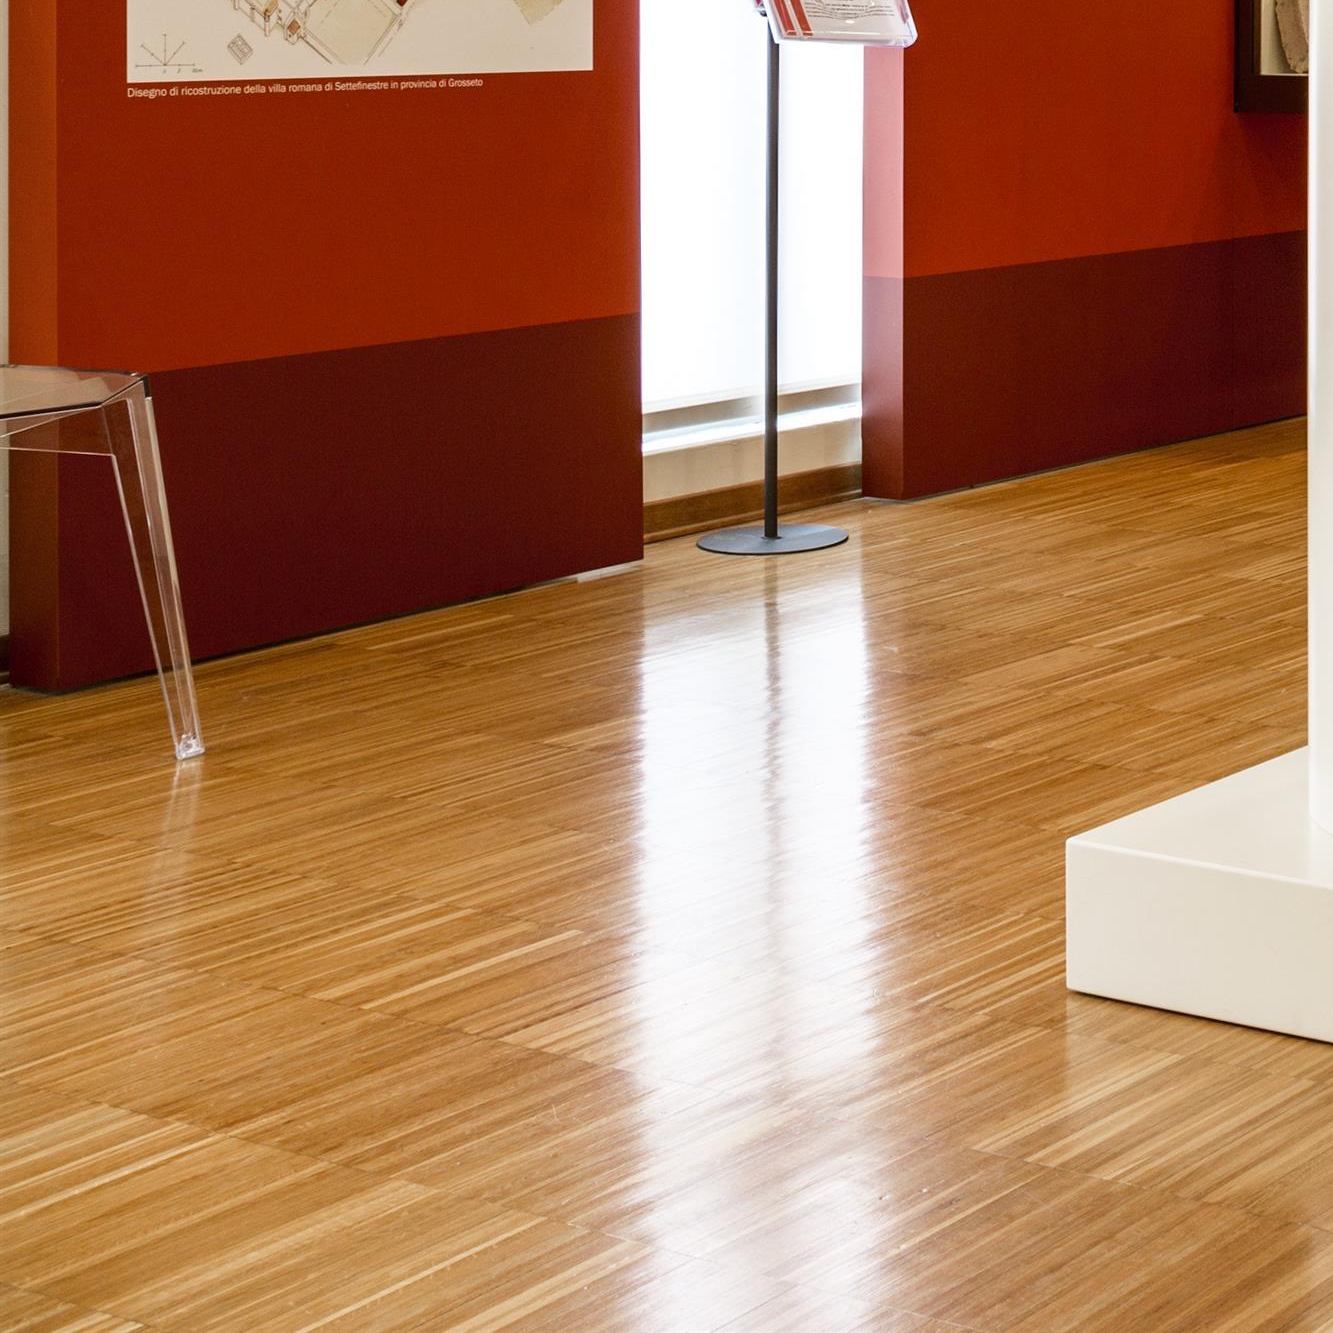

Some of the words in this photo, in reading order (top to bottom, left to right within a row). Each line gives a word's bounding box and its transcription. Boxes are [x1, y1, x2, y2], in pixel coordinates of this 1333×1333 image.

[127, 87, 167, 99] Disegno
[168, 86, 179, 96] di
[180, 84, 242, 96] ricostruzione
[243, 83, 266, 94] della
[267, 83, 286, 93] villa
[288, 83, 323, 92] romana
[324, 82, 333, 91] di
[334, 80, 389, 91] Settefinestre
[390, 81, 399, 89] in
[400, 79, 437, 90] provincia
[438, 78, 446, 87] di
[447, 77, 483, 87] Grosseto
